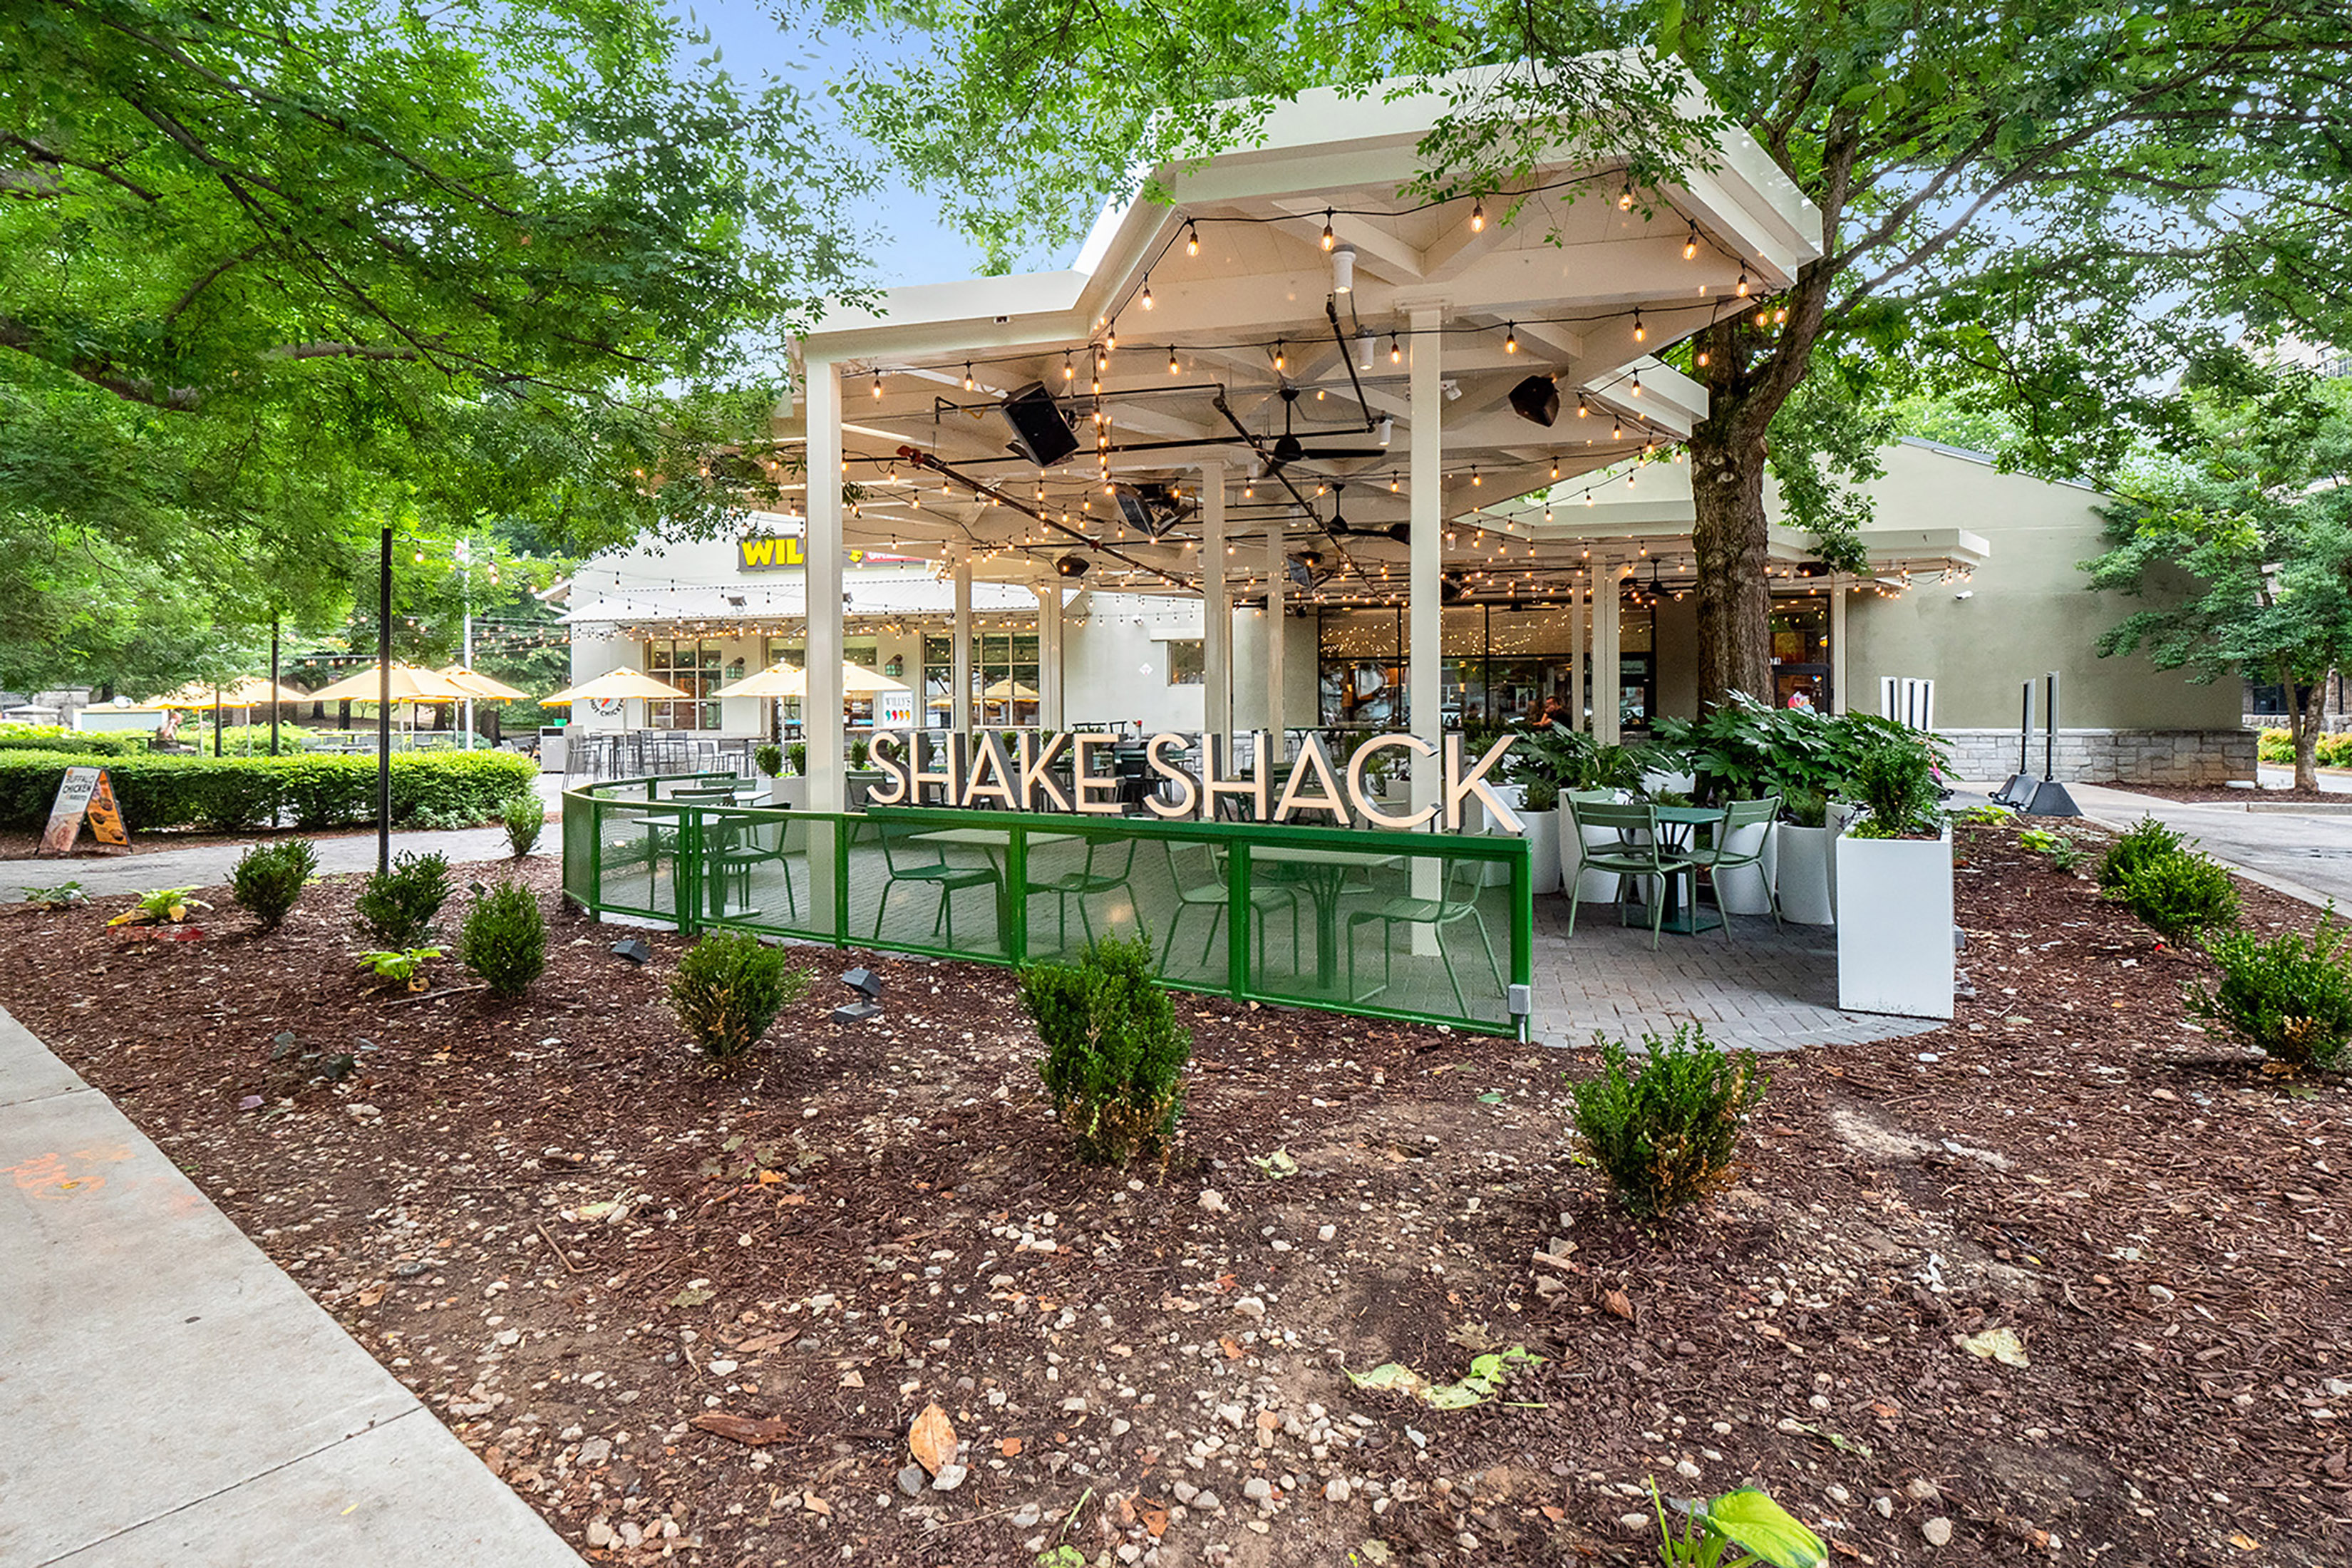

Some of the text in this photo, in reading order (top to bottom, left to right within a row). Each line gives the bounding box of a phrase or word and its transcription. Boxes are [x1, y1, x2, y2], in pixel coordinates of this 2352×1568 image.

[63, 784, 92, 794] CHICKEN
[867, 731, 1524, 833] SHAKE SHACK
